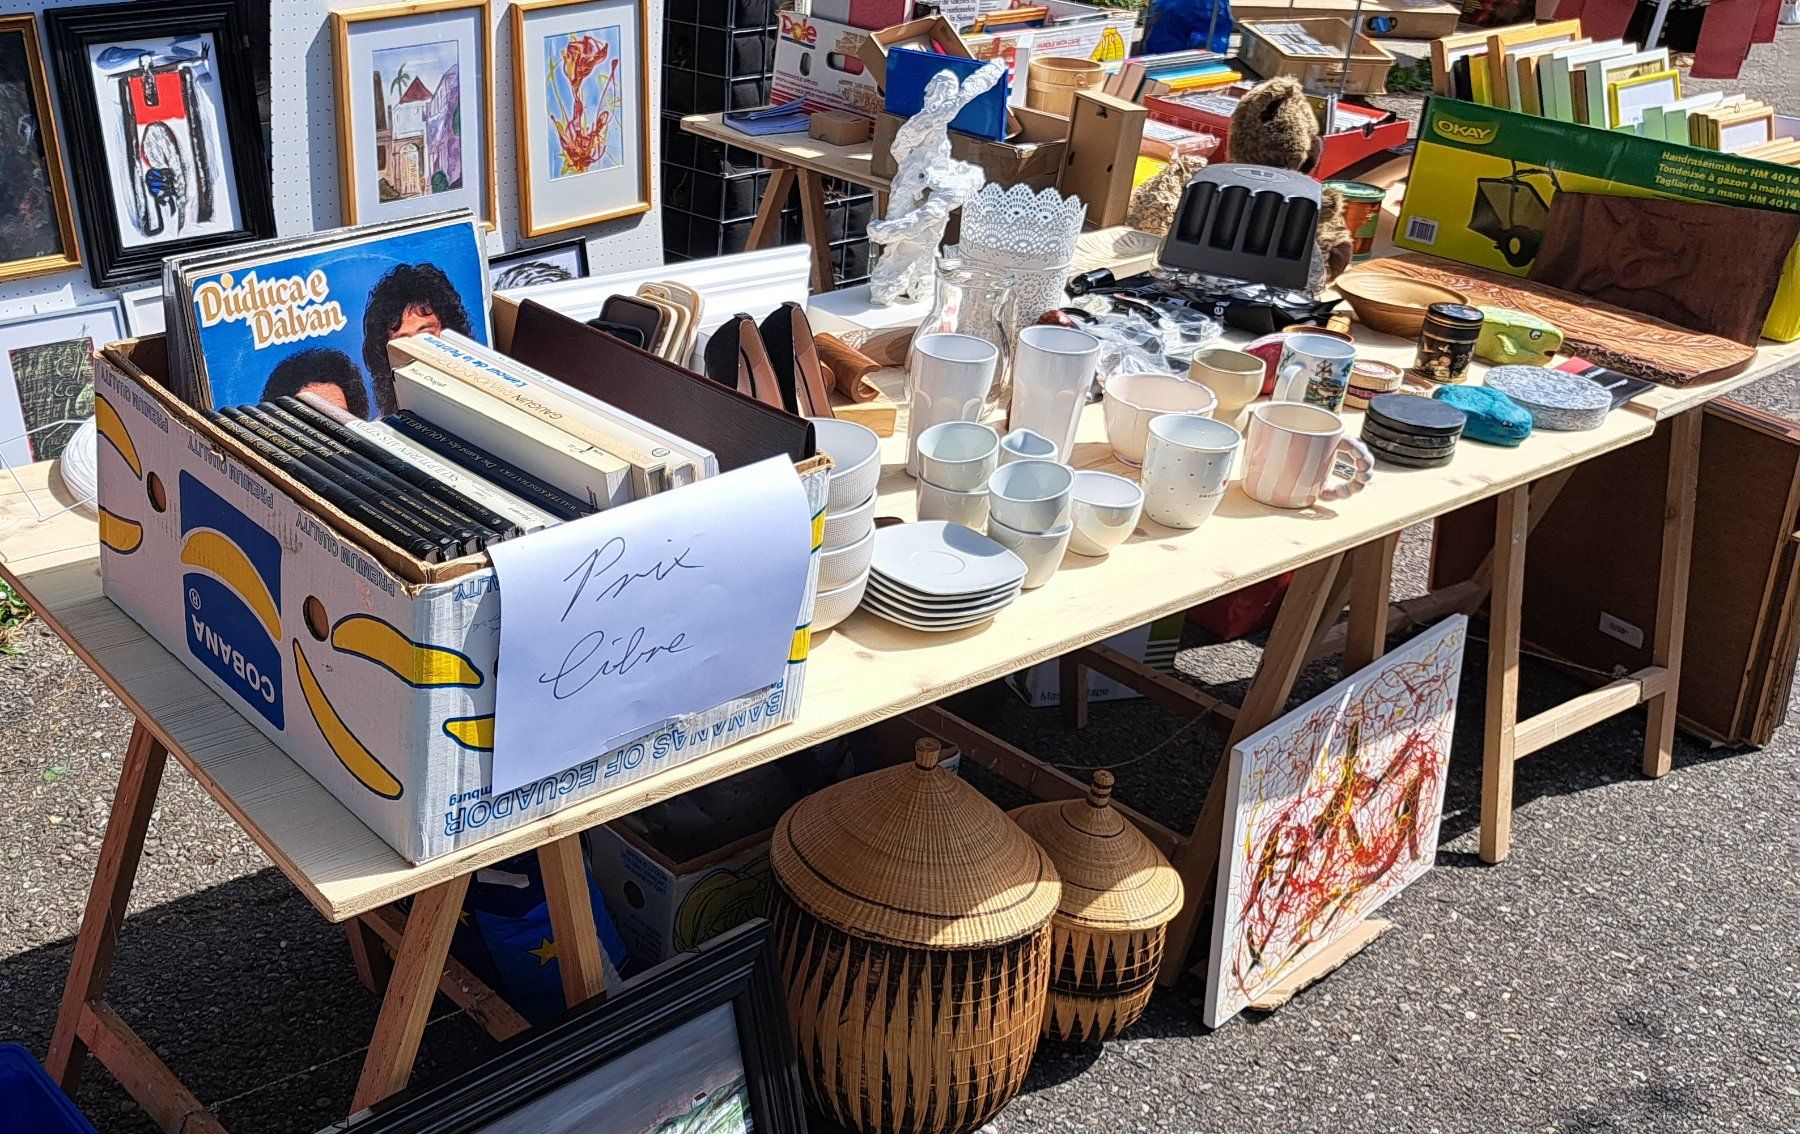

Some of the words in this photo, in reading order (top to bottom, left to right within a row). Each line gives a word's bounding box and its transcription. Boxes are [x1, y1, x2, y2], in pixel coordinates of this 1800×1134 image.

[781, 15, 818, 44] Dole
[1437, 119, 1491, 139] OKAY
[1658, 163, 1706, 180] Tondeuse
[1716, 176, 1749, 189] gazon
[1758, 184, 1785, 195] main
[1661, 151, 1748, 175] Handrasenmäher
[1749, 168, 1769, 179] HM
[1654, 175, 1706, 193] Tagliaerba
[1716, 188, 1746, 201] mano
[1748, 194, 1767, 205] HM
[308, 271, 327, 300] e
[250, 302, 346, 347] Dalvan
[422, 336, 464, 359] Peinture
[462, 354, 473, 363] la
[472, 360, 487, 370] de
[101, 365, 131, 401] QUALITY
[131, 390, 169, 433] PREMIUM
[228, 464, 274, 509] PREMIUM
[296, 511, 339, 557] QUALITY
[340, 546, 396, 597] PREMIUM
[561, 537, 705, 622] Prix
[191, 613, 275, 704] COBANA
[604, 743, 645, 779] OF
[444, 759, 599, 836] ECUADOR
[448, 784, 493, 806] mburg
